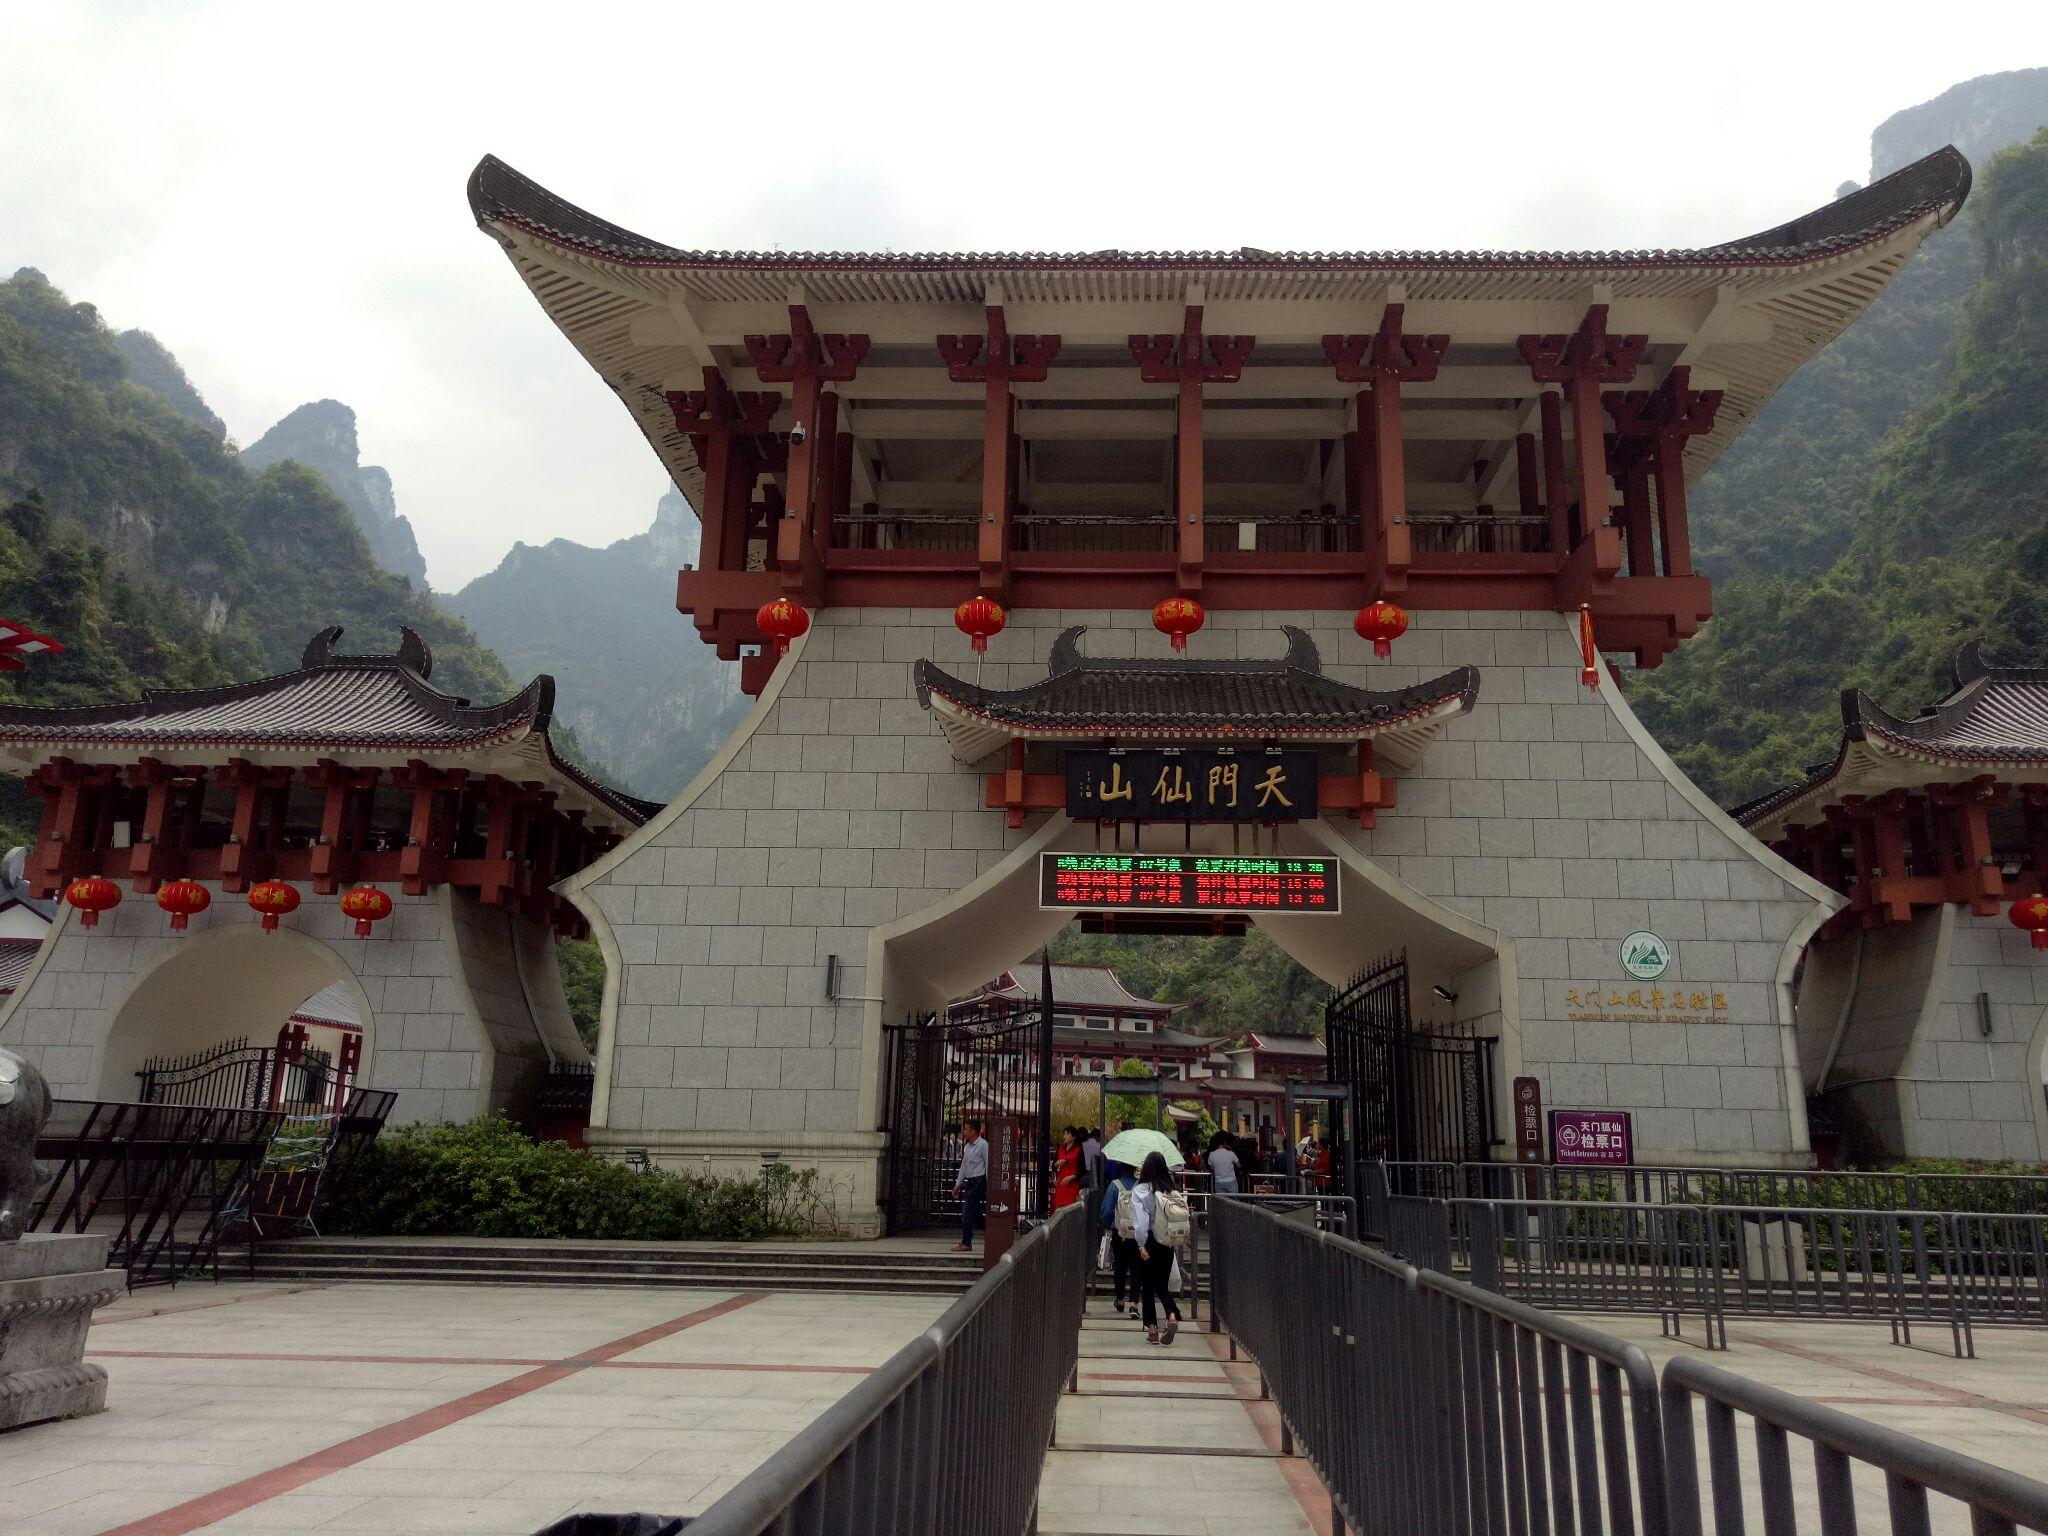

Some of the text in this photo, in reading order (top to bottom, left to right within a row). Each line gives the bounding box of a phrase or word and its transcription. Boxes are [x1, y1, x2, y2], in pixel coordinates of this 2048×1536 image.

[1524, 1104, 1537, 1141] 检票口
[1580, 1121, 1621, 1133] 天门狐仙
[1581, 1133, 1622, 1149] 检票口
[1560, 1149, 1599, 1158] Ticket Entrance
